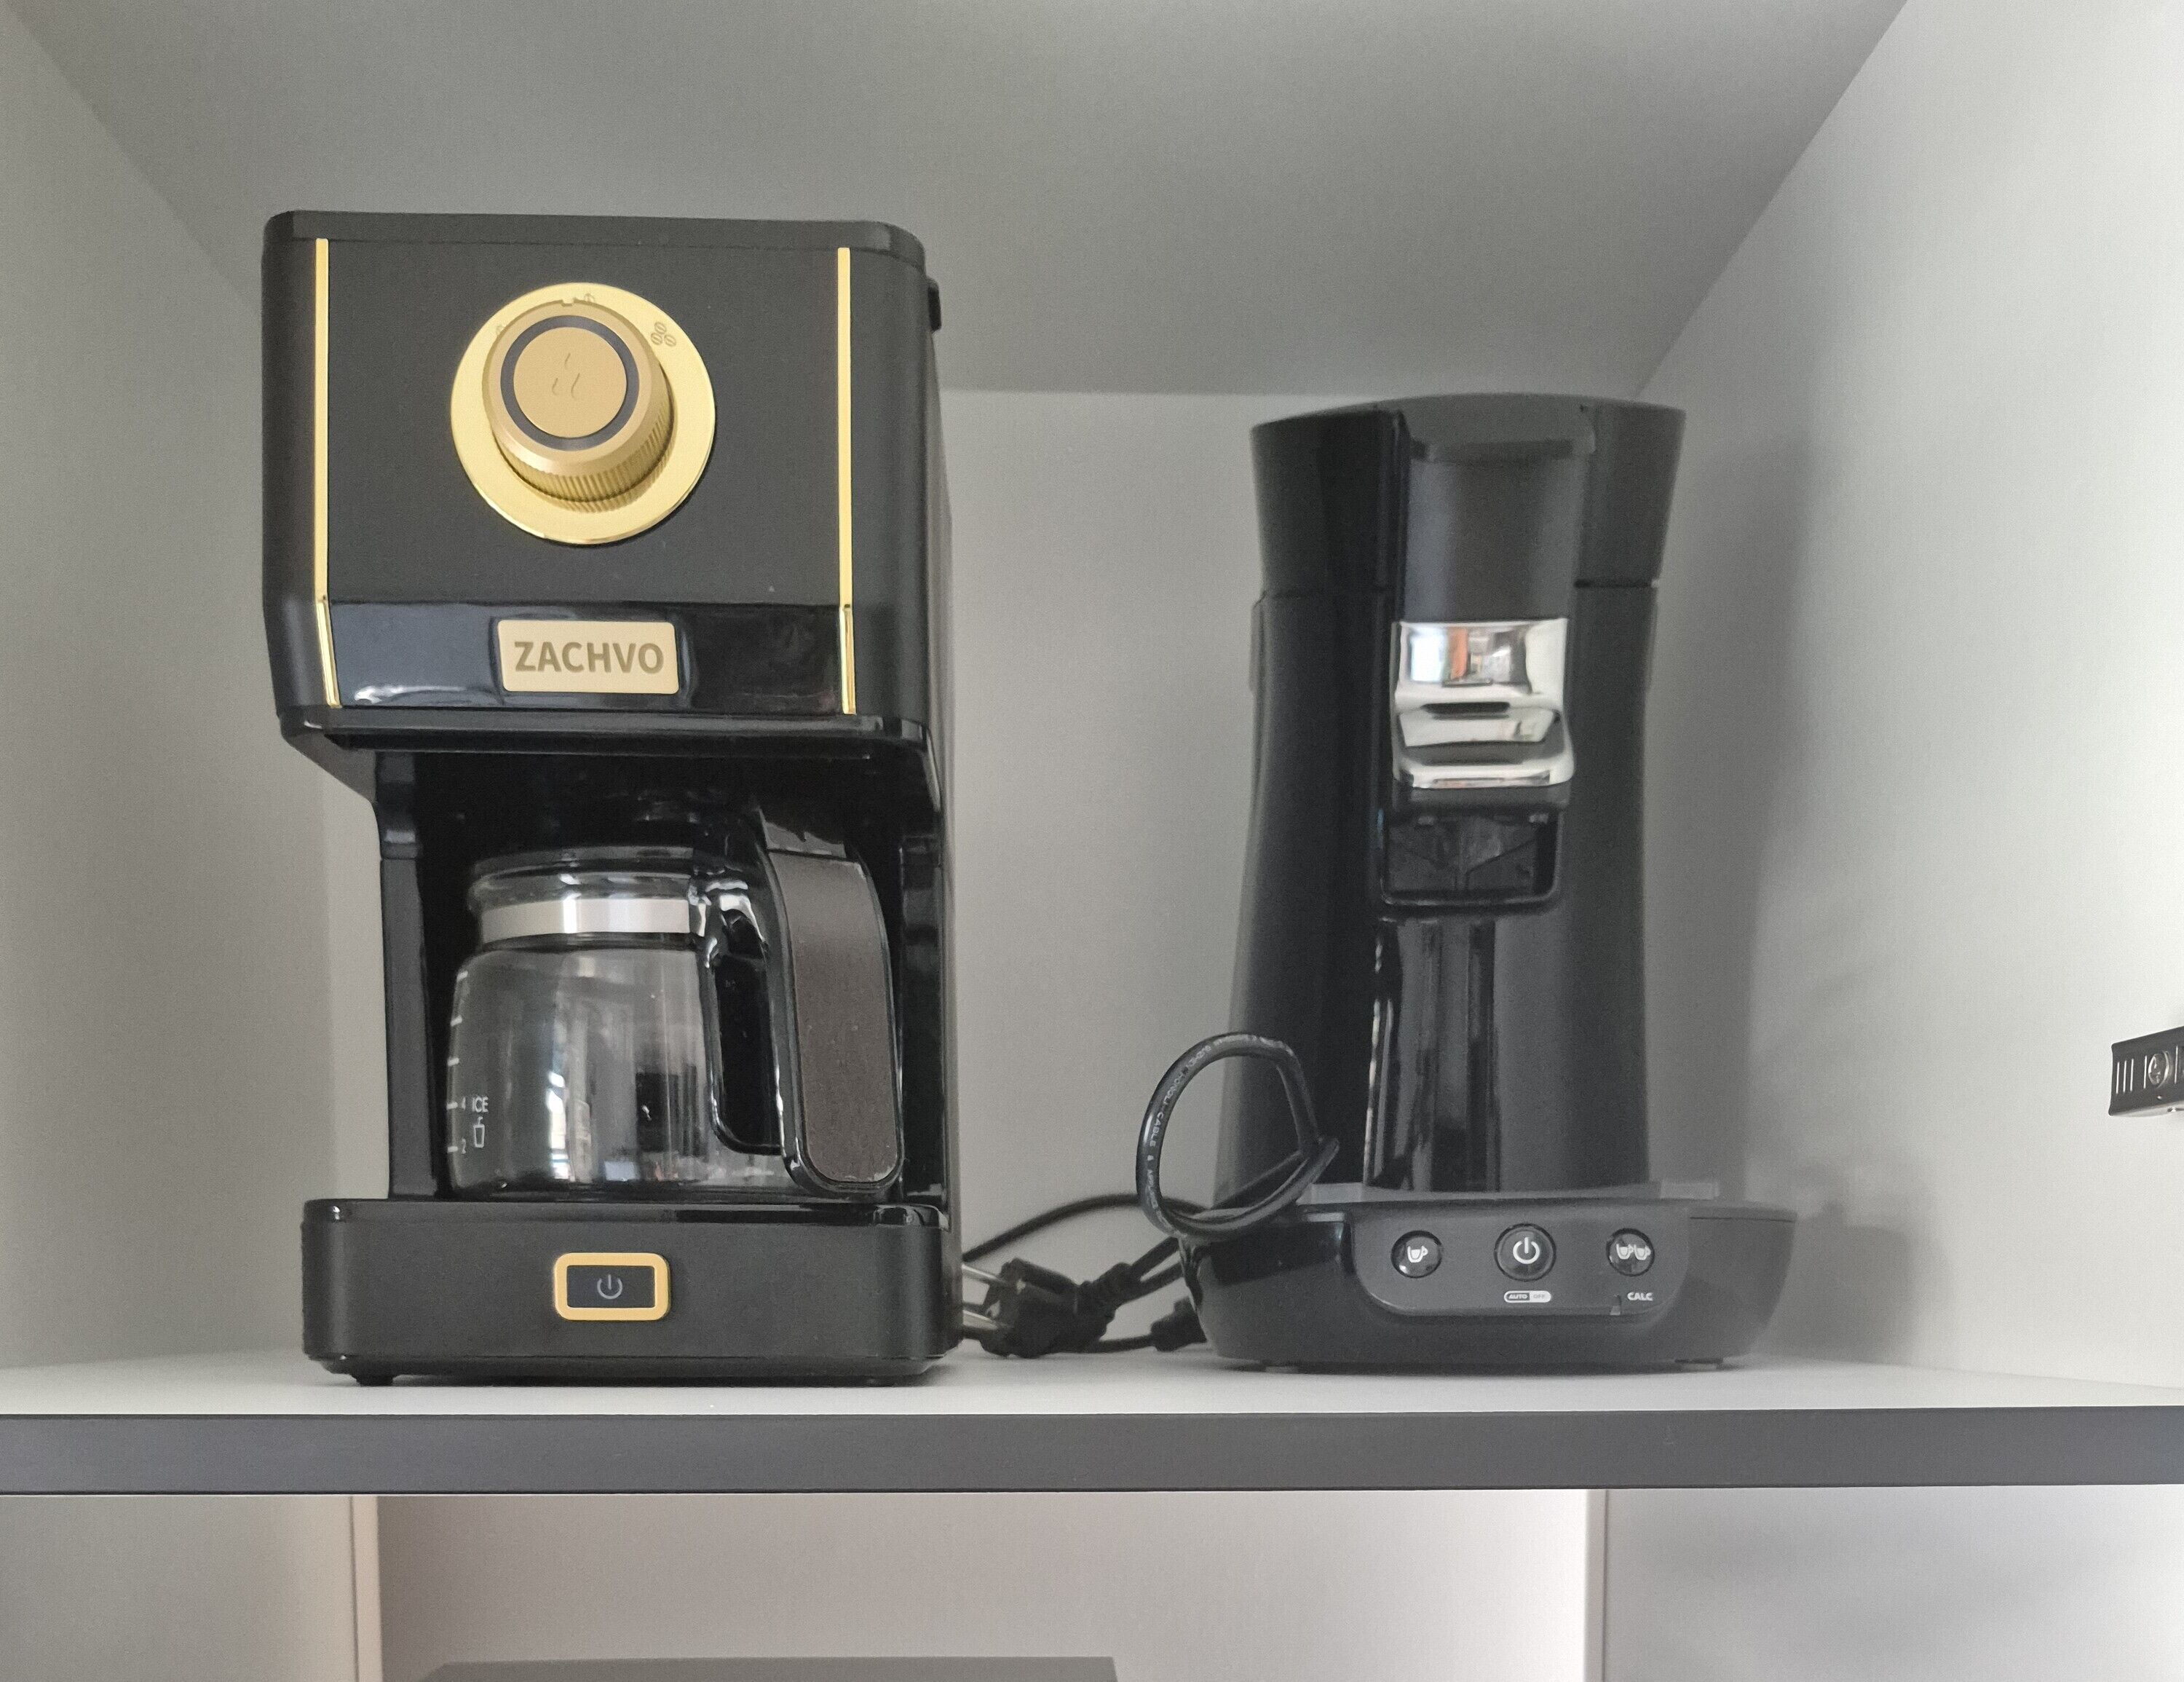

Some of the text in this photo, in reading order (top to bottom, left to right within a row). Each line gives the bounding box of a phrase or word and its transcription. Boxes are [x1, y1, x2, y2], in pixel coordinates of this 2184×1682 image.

[514, 641, 664, 674] ZACHVO
[472, 1096, 488, 1113] ICE
[1149, 1111, 1164, 1147] CABLE
[1627, 1292, 1653, 1301] CALC
